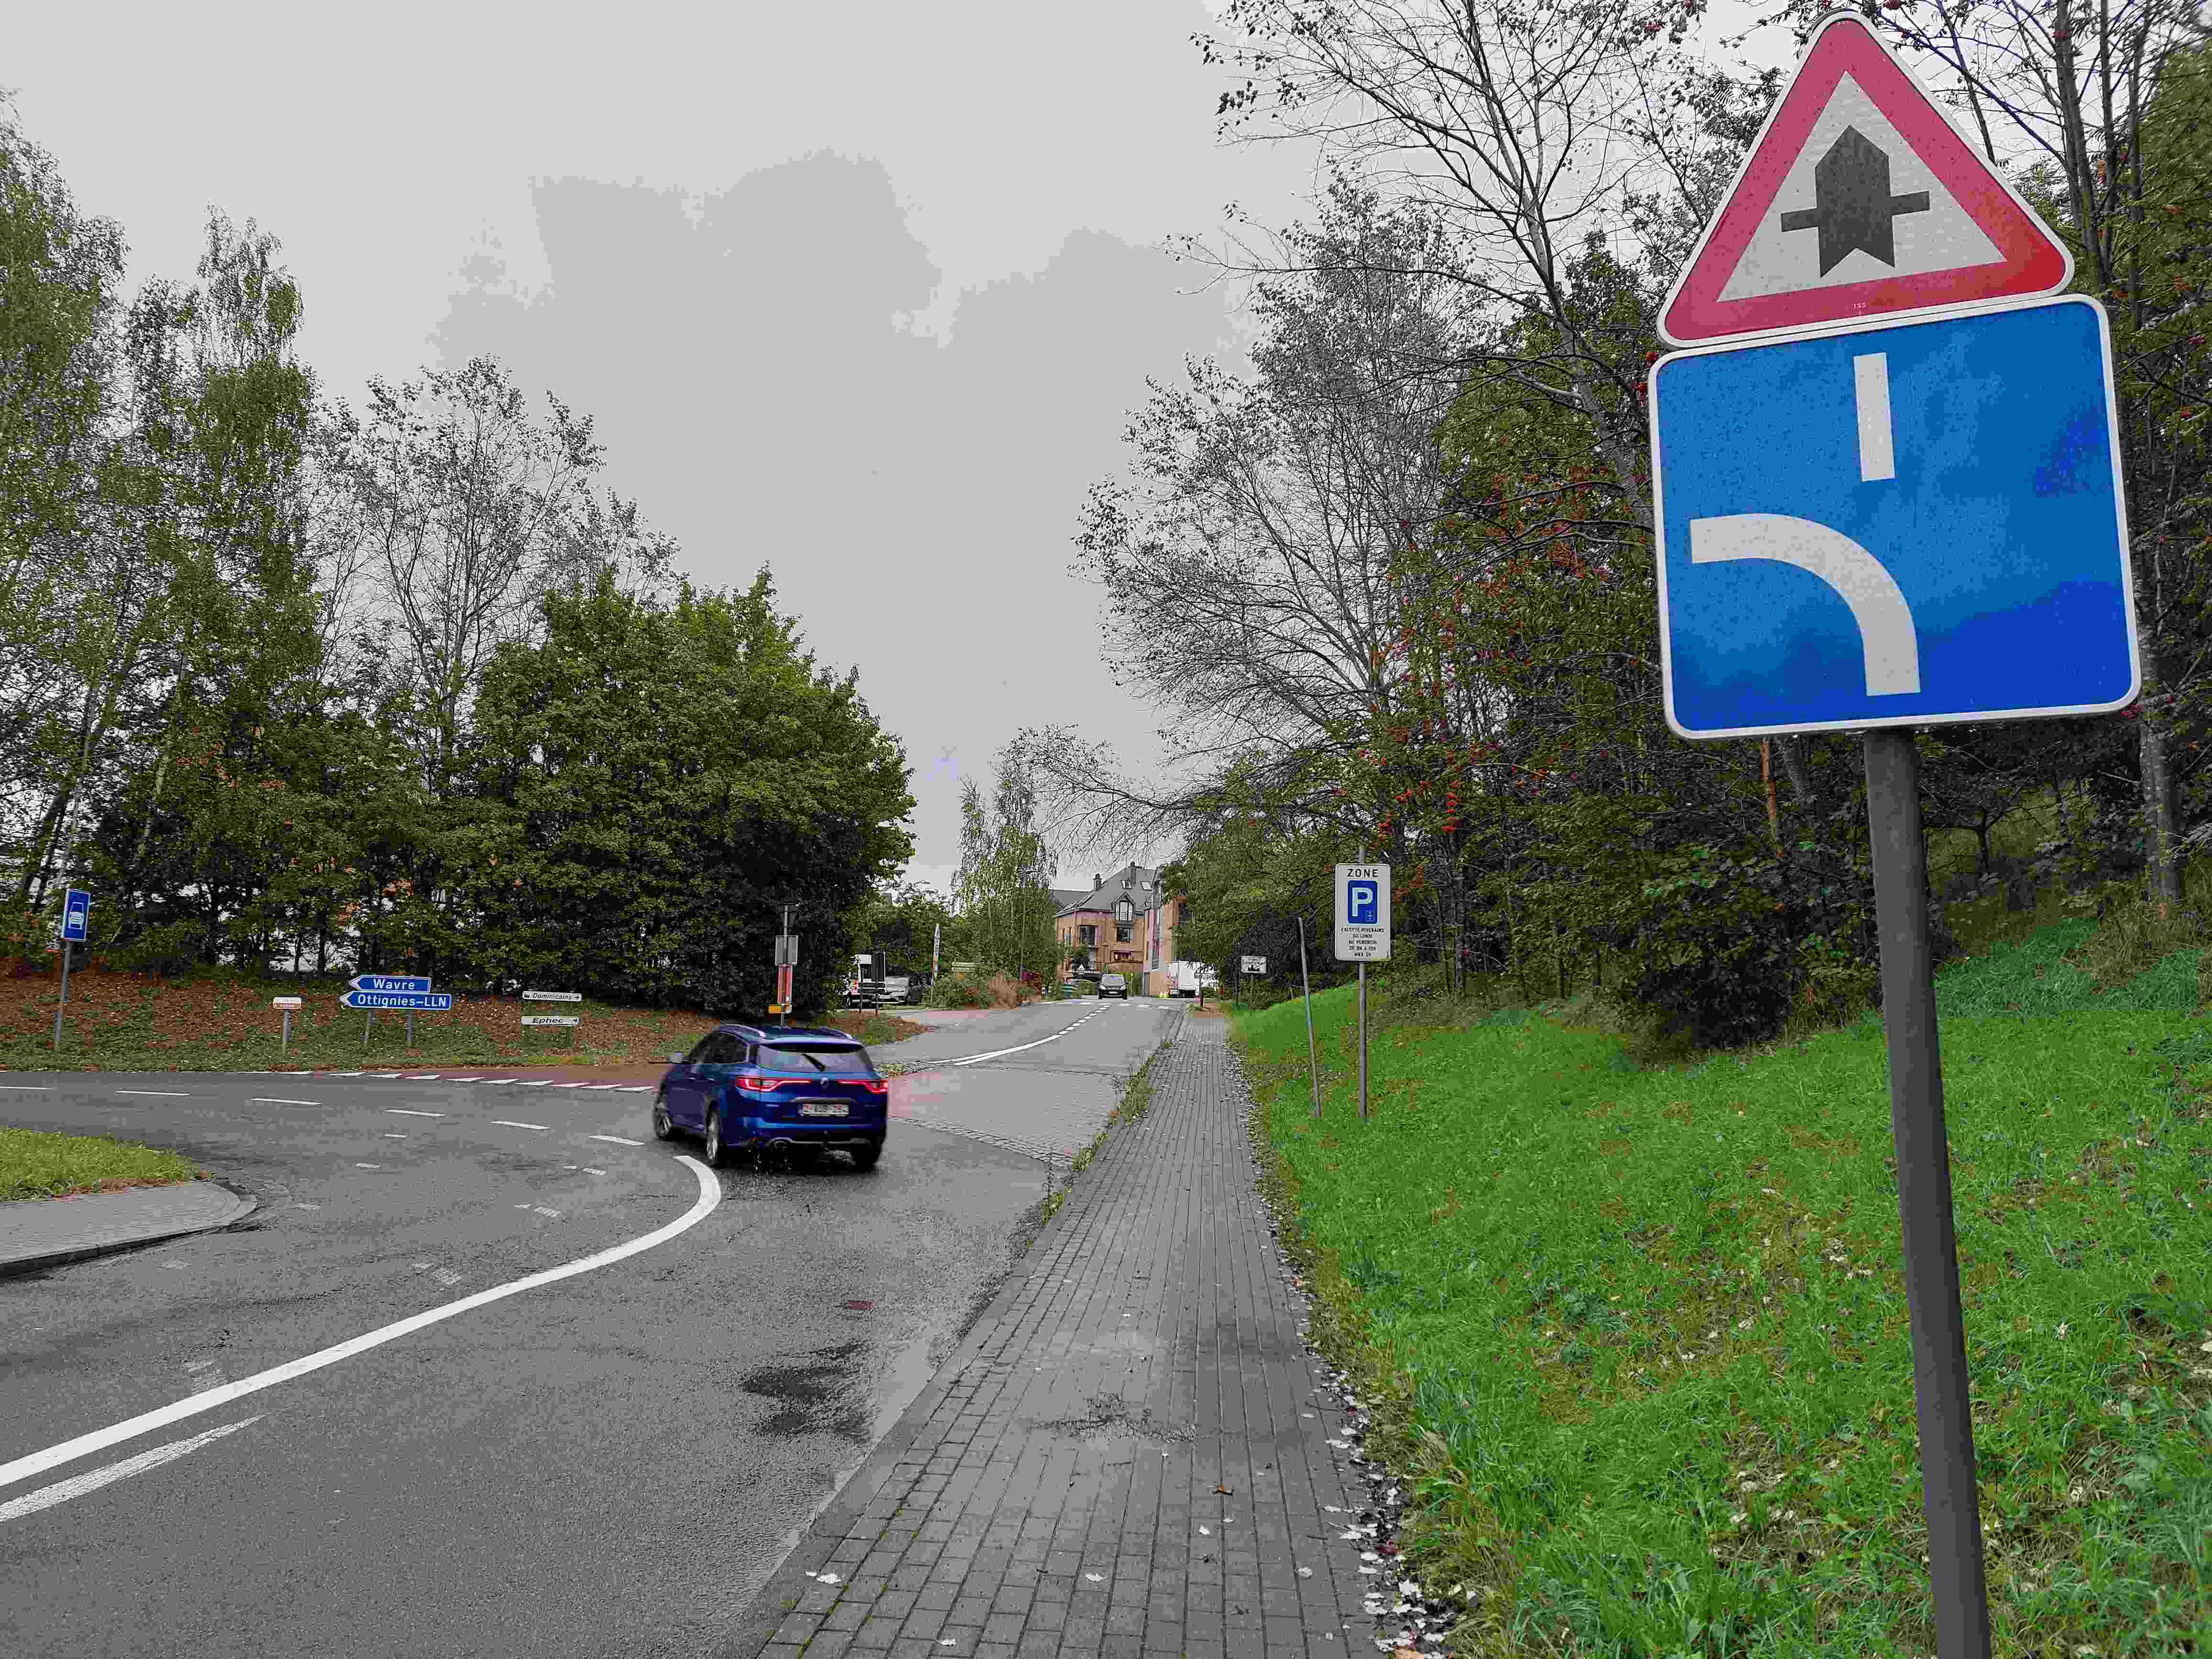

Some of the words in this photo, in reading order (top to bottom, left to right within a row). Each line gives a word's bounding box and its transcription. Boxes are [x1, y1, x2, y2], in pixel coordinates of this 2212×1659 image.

[1348, 868, 1378, 877] ZONE
[1352, 887, 1373, 917] P
[373, 979, 415, 990] Wavre
[358, 994, 447, 1007] Ottignies-LLN
